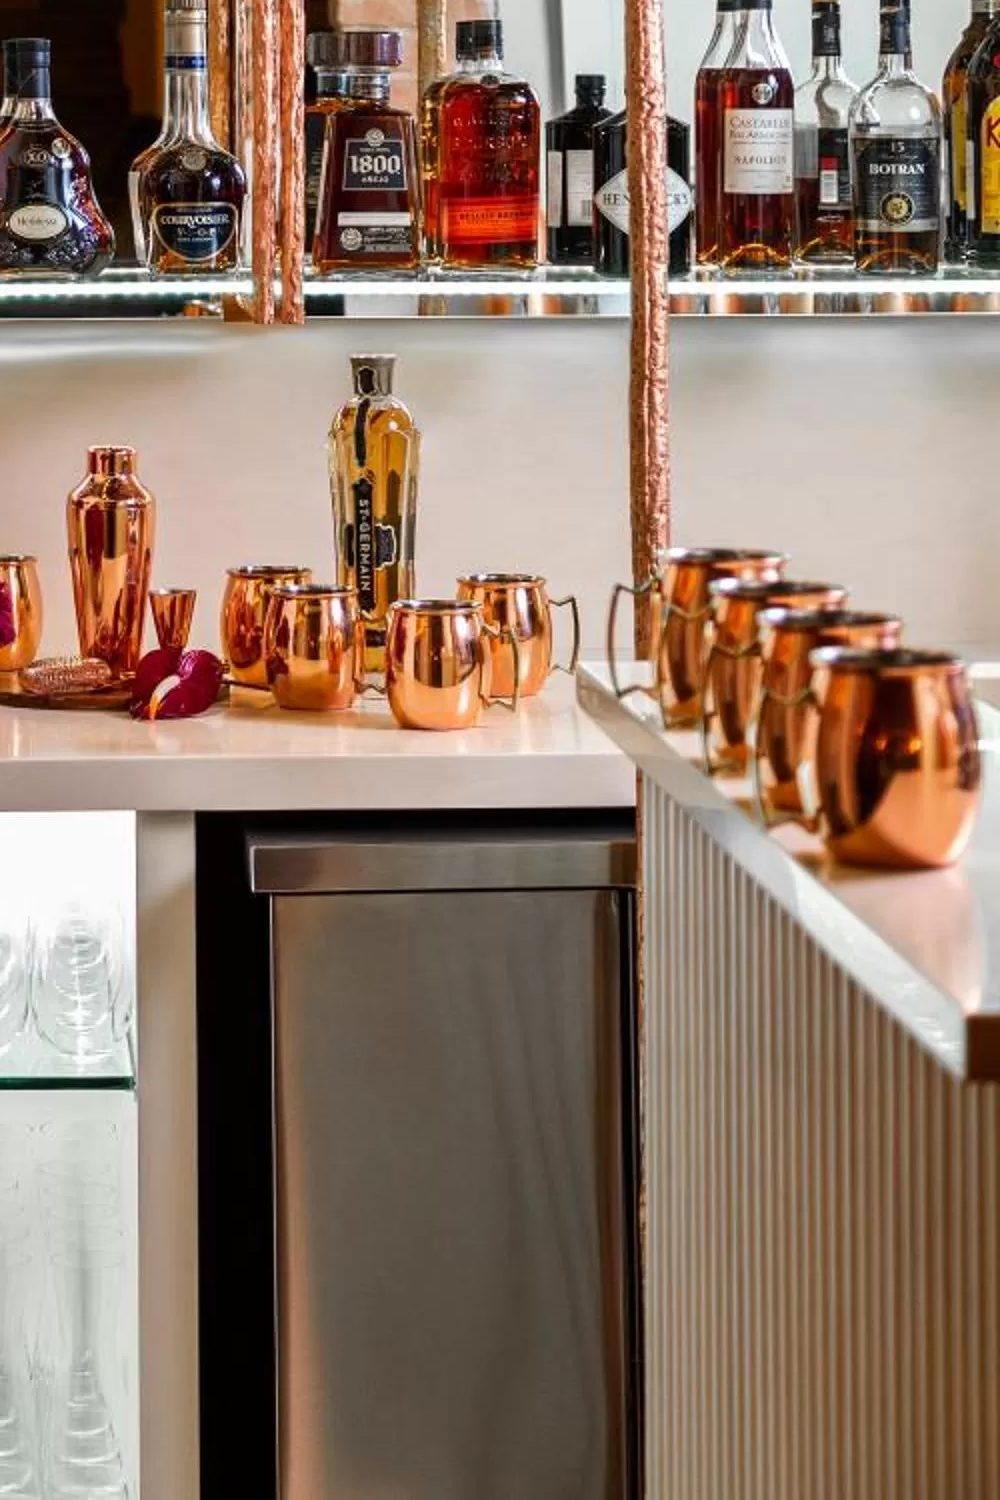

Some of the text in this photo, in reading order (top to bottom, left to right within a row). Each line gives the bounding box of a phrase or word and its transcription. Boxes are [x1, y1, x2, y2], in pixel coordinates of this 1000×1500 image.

[890, 141, 904, 153] 15
[349, 154, 402, 174] 1800
[869, 162, 926, 175] BOTRAN
